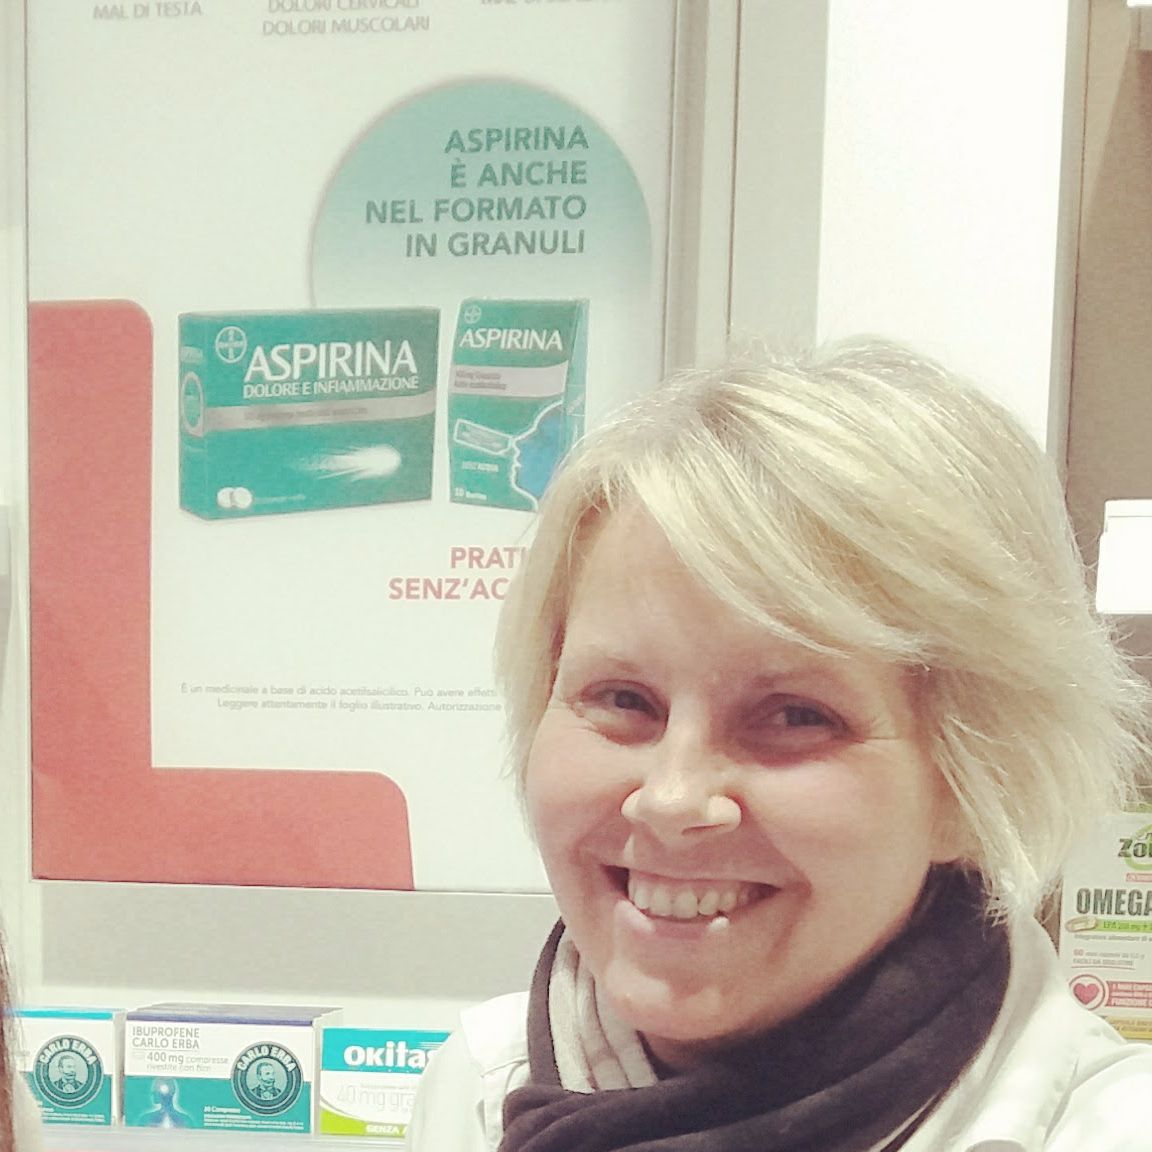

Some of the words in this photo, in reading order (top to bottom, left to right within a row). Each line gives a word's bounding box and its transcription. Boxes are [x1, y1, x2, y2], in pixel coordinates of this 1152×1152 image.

[93, 4, 129, 20] MAL
[133, 3, 150, 19] DI
[155, 2, 202, 18] TESTA
[262, 18, 327, 37] DOLORI
[331, 15, 430, 35] MUSCOLARI
[444, 125, 589, 153] ASPIRINA
[450, 158, 467, 188] È
[477, 160, 587, 187] ANCHE
[365, 199, 423, 224] NEL
[434, 194, 587, 222] FORMATO
[406, 233, 437, 257] IN
[447, 229, 585, 256] GRANULI
[459, 328, 563, 350] ASPIRINA
[243, 340, 418, 382] ASPIRINA
[243, 381, 298, 400] DOLORE
[301, 380, 310, 396] E
[314, 376, 419, 395] INFIAMMAZIONE
[132, 1026, 200, 1039] IBUPROFENE
[132, 1037, 169, 1048] CARLO
[172, 1038, 200, 1050] ERBA
[39, 1038, 70, 1065] CARLO
[71, 1039, 98, 1066] ERBA
[146, 1052, 166, 1063] 400
[168, 1054, 184, 1065] mg
[237, 1045, 270, 1072] CARLO
[271, 1045, 298, 1073] ERBA
